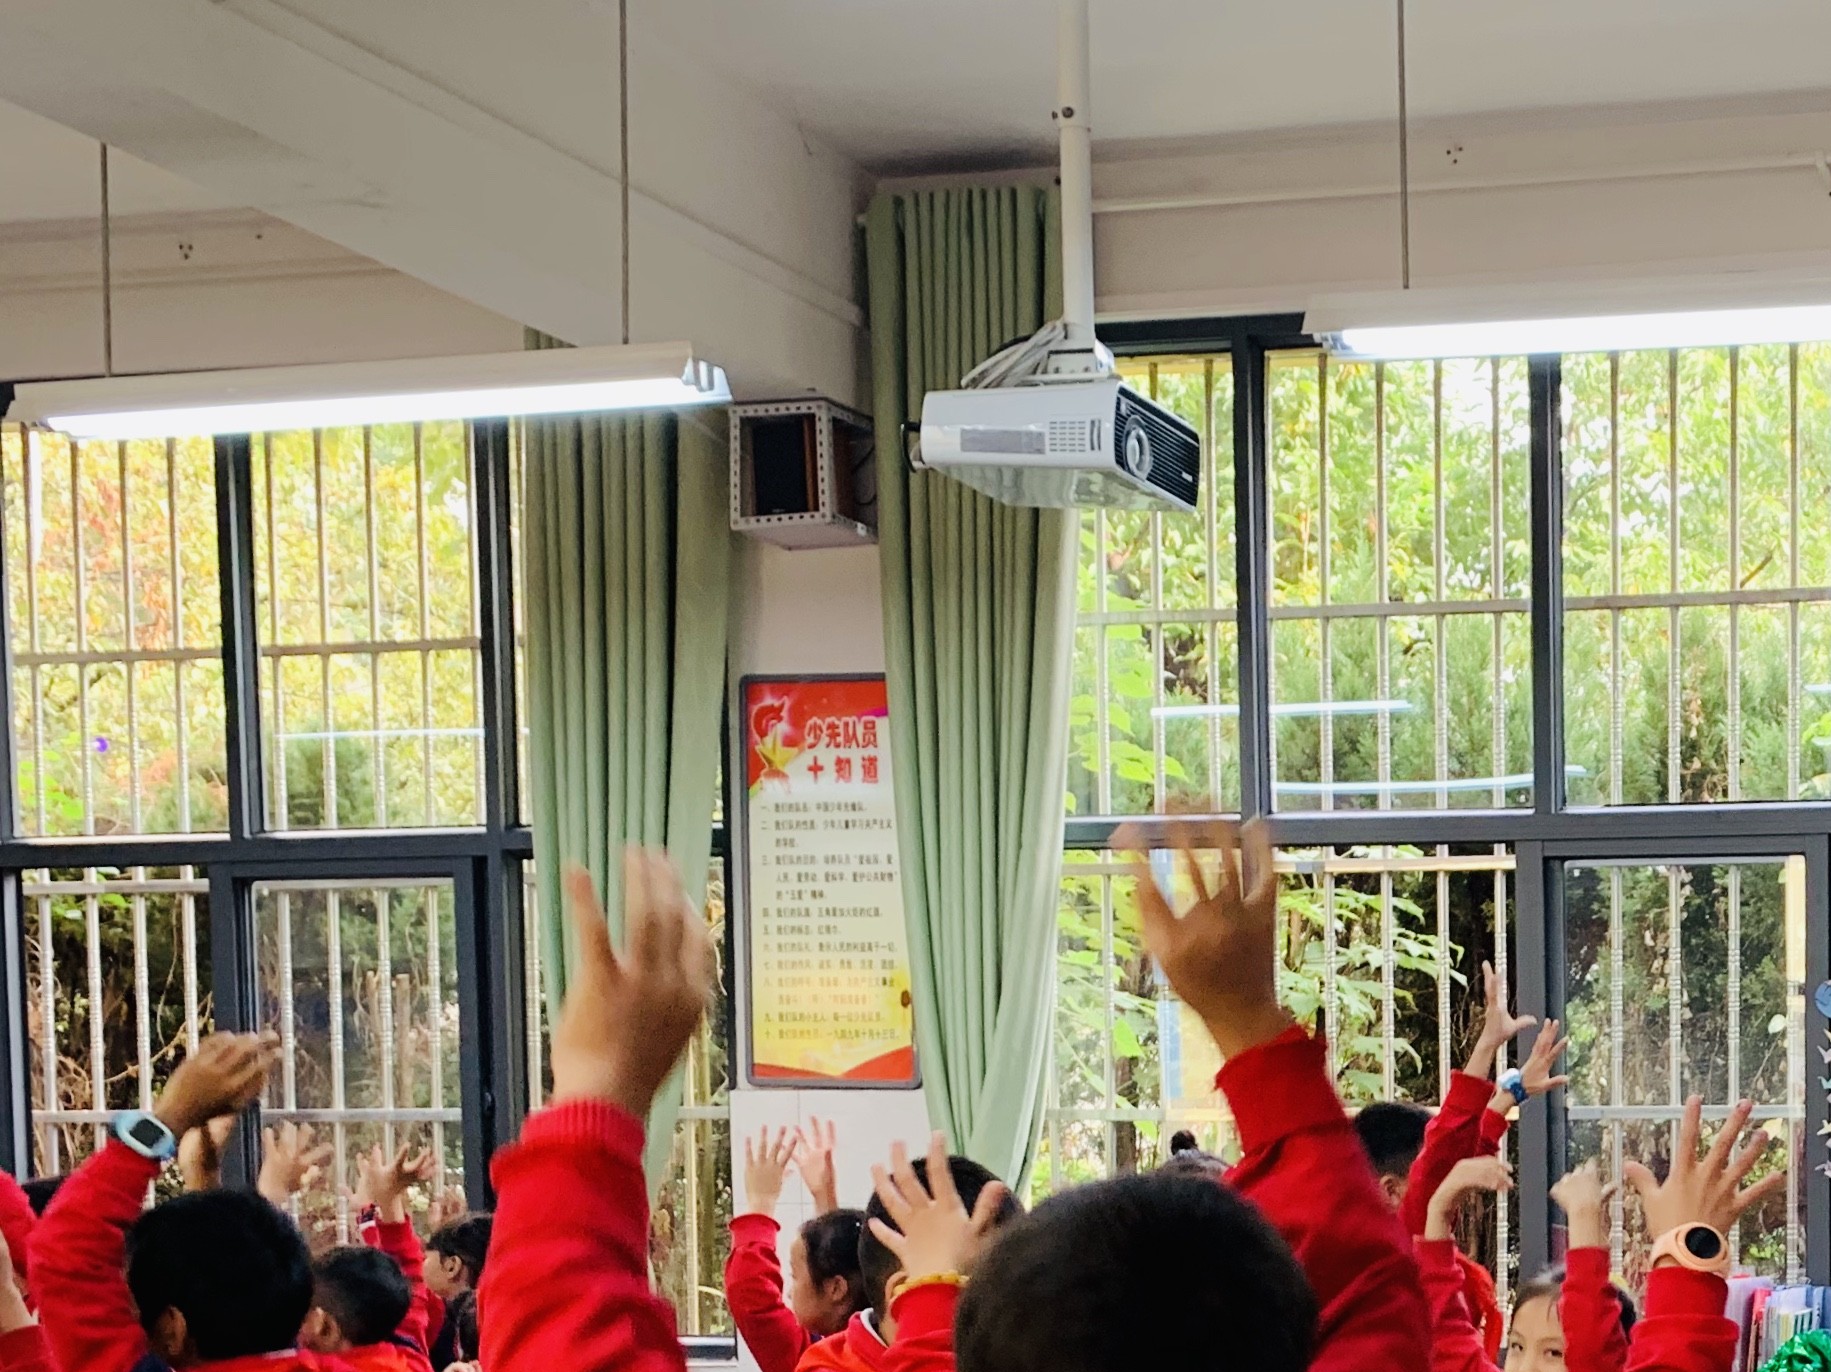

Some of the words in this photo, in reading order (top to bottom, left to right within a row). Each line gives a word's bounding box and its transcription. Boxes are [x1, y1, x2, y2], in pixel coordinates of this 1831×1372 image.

[805, 717, 879, 750] 少先队员
[806, 754, 879, 784] 十知道
